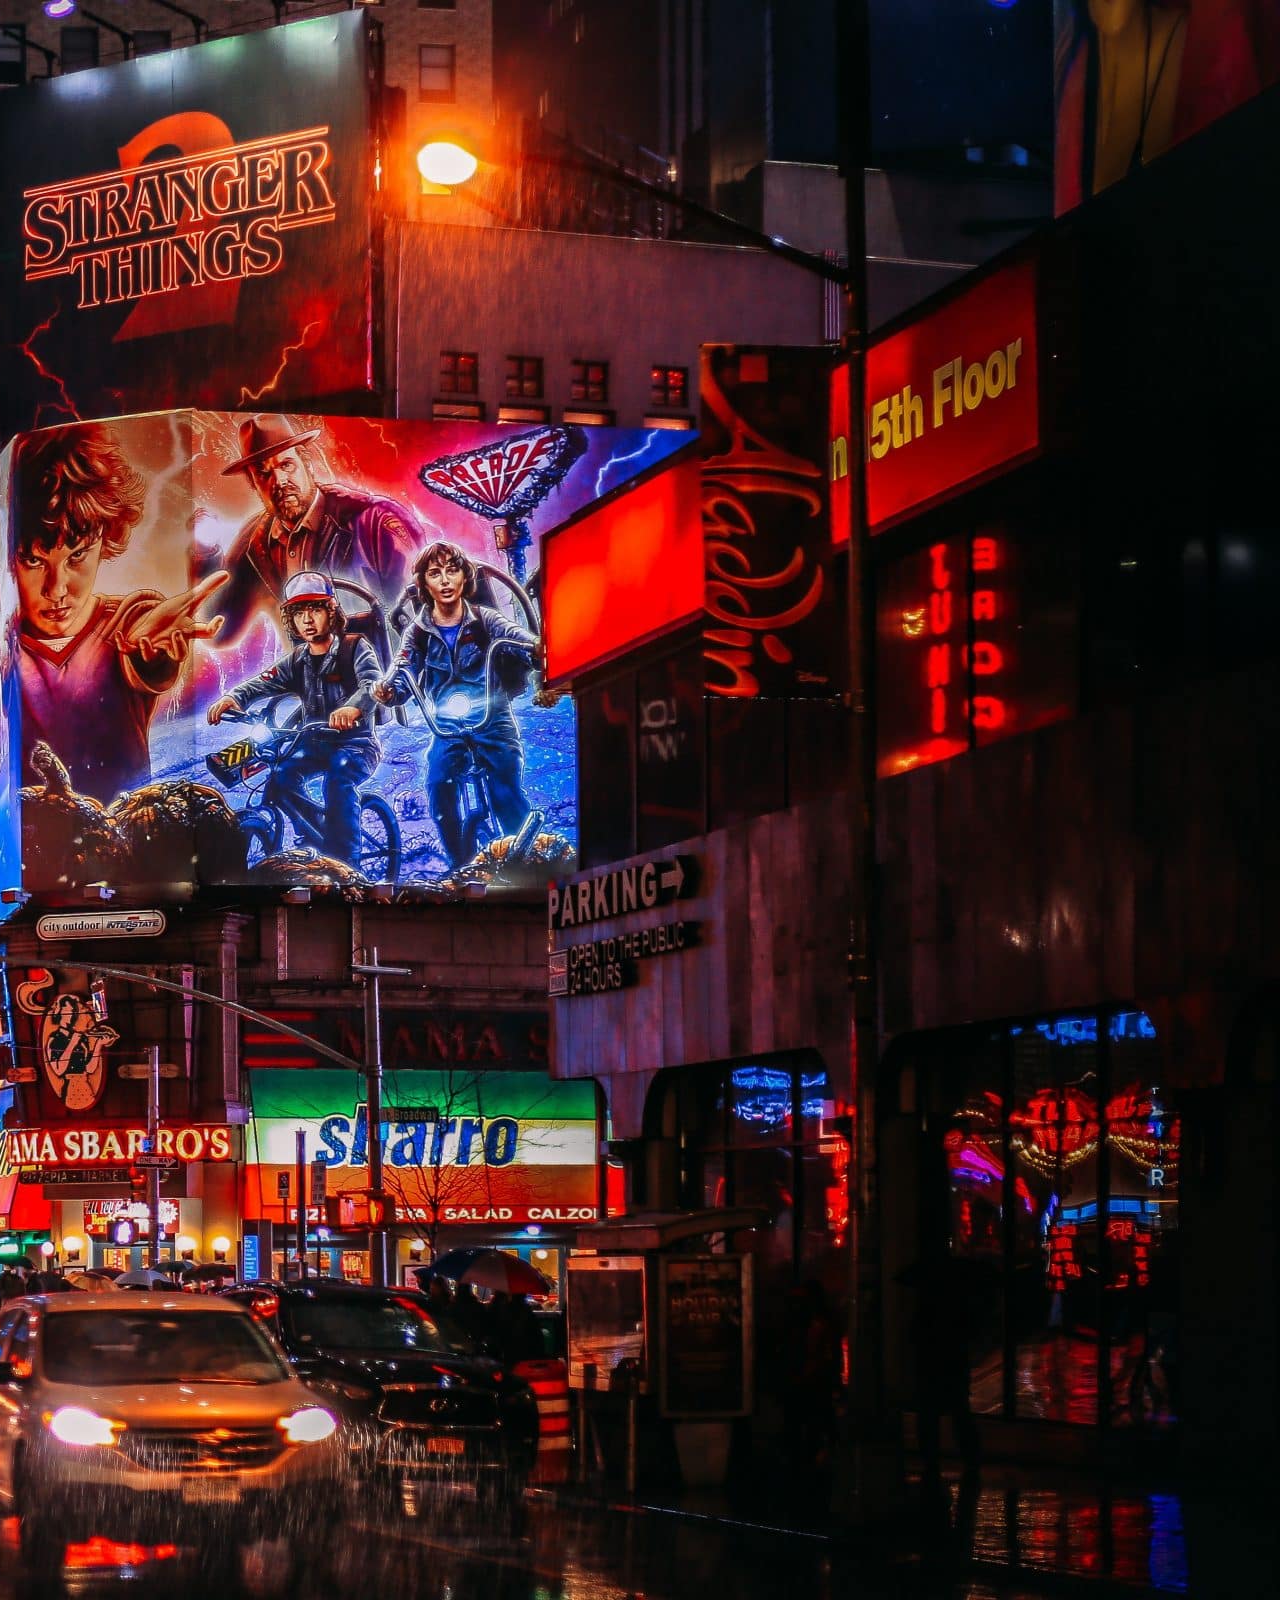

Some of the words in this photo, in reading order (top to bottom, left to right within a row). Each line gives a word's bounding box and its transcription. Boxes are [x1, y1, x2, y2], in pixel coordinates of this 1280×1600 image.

[24, 141, 335, 270] STRANGER
[111, 112, 240, 343] 2
[70, 216, 283, 309] THINGS
[867, 384, 925, 463] 5th
[931, 337, 1023, 430] Floor
[428, 433, 561, 488] ARCADE
[548, 862, 657, 930] PARKING
[43, 922, 60, 933] city
[63, 920, 101, 931] outdoor
[106, 919, 160, 929] INTERSTATE
[570, 943, 598, 969] OPEN
[601, 938, 616, 962] TO
[619, 933, 640, 958] THE
[643, 921, 684, 953] PUBLIC
[570, 971, 582, 994] 24
[584, 963, 621, 991] HOURS
[8, 1130, 58, 1163] AMA
[63, 1128, 229, 1163] SBARRO'S
[315, 1104, 518, 1168] sbarro
[290, 1208, 328, 1221] PIZ
[394, 1207, 427, 1220] STA
[445, 1207, 513, 1220] SALAD
